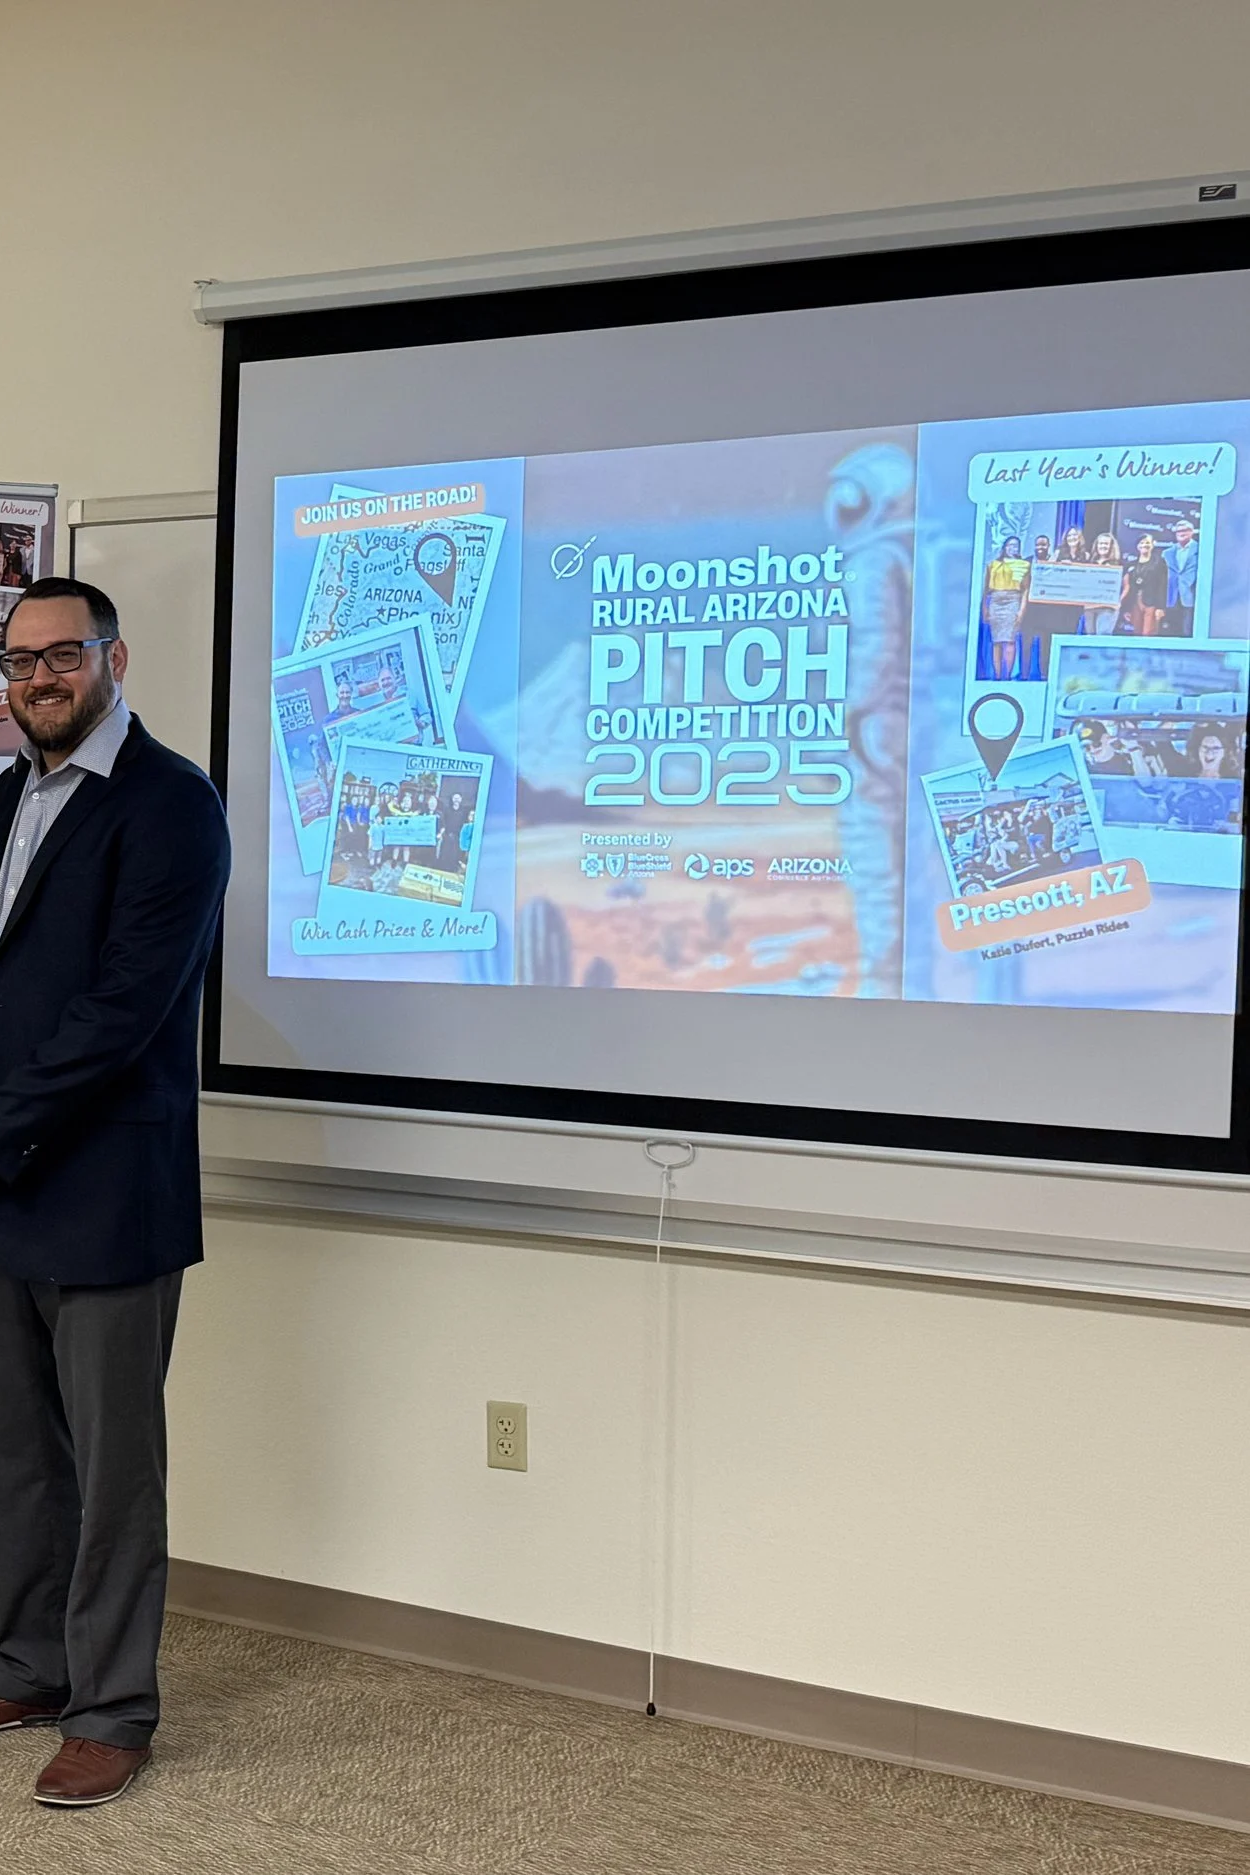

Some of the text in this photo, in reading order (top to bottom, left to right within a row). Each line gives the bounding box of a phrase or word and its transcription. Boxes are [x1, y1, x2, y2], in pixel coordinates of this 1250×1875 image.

[984, 446, 1224, 488] Last Year's Winner!
[0, 501, 43, 516] Winner!
[301, 485, 477, 525] JOIN US ON THE ROAD!
[364, 532, 407, 551] Vegas
[363, 552, 400, 574] Grand
[592, 545, 844, 594] Moonshot
[337, 560, 360, 628] Colorado
[363, 588, 423, 603] ARIZONA
[592, 587, 848, 628] RURAL ARIZONA
[590, 624, 849, 706] PITCH
[586, 702, 844, 741] COMPETITION
[409, 757, 481, 772] GATHERING
[584, 739, 853, 806] 2025
[581, 832, 672, 849] Presented by
[712, 857, 754, 879] aps
[767, 858, 853, 875] ARIZONA
[949, 865, 1134, 931] Prescott, AZ
[301, 915, 488, 941] Win Cash Prizes & More!
[981, 946, 1012, 961] Katie
[1057, 927, 1094, 944] Puzzle
[1096, 919, 1130, 935] Rides
